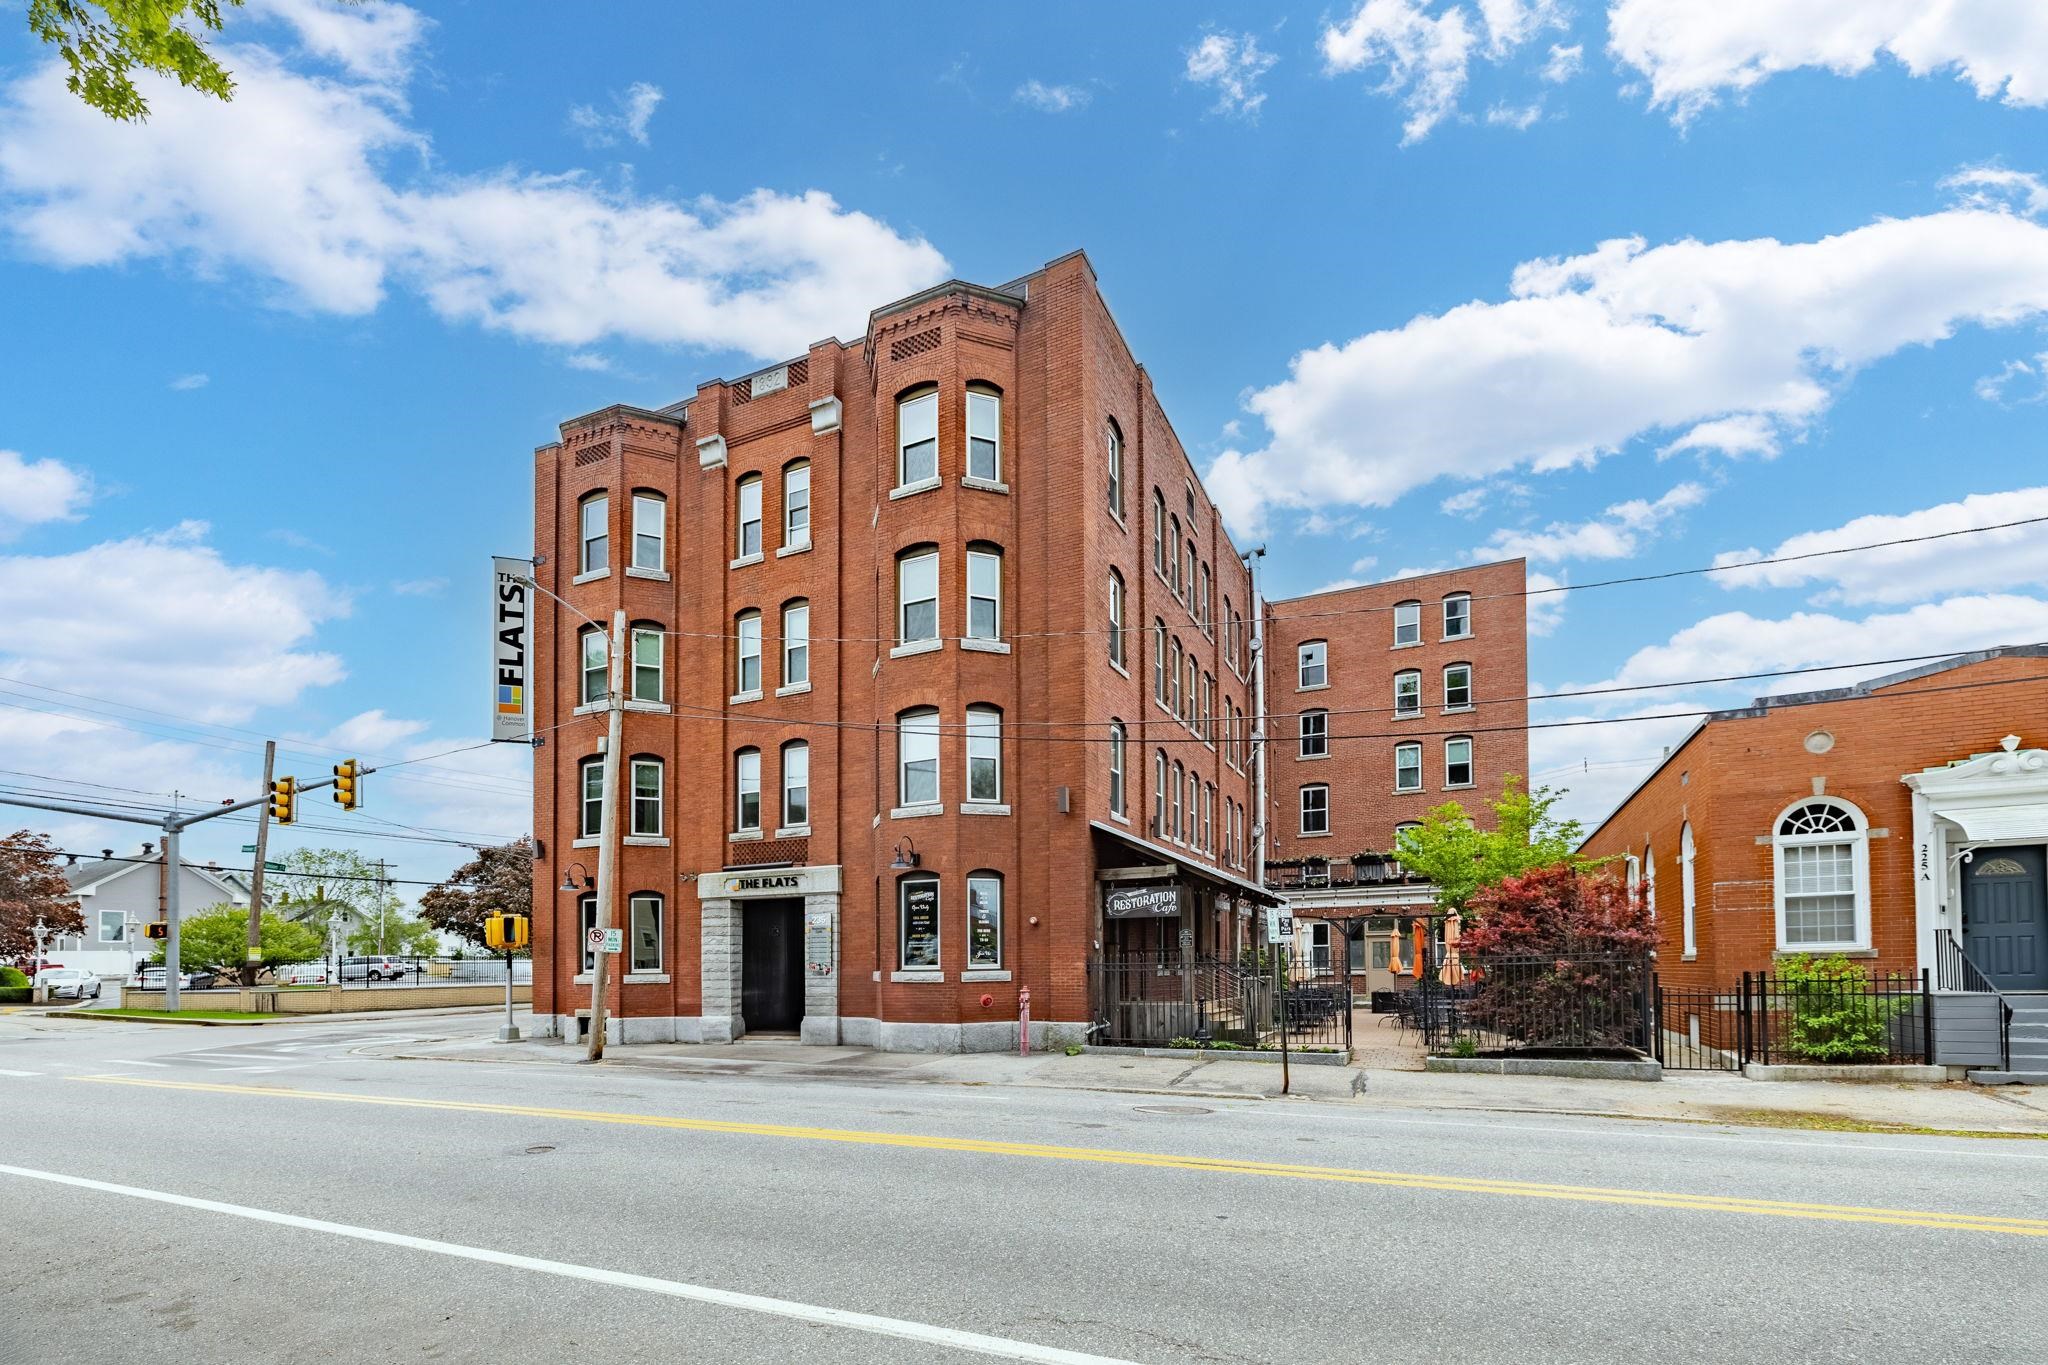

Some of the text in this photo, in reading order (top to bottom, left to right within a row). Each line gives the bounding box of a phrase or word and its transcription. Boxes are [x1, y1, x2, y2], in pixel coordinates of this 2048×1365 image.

[499, 585, 524, 687] FLATS
[739, 876, 798, 889] THE FLATS
[1113, 890, 1177, 911] RESTORATION
[1153, 901, 1178, 914] Cafe
